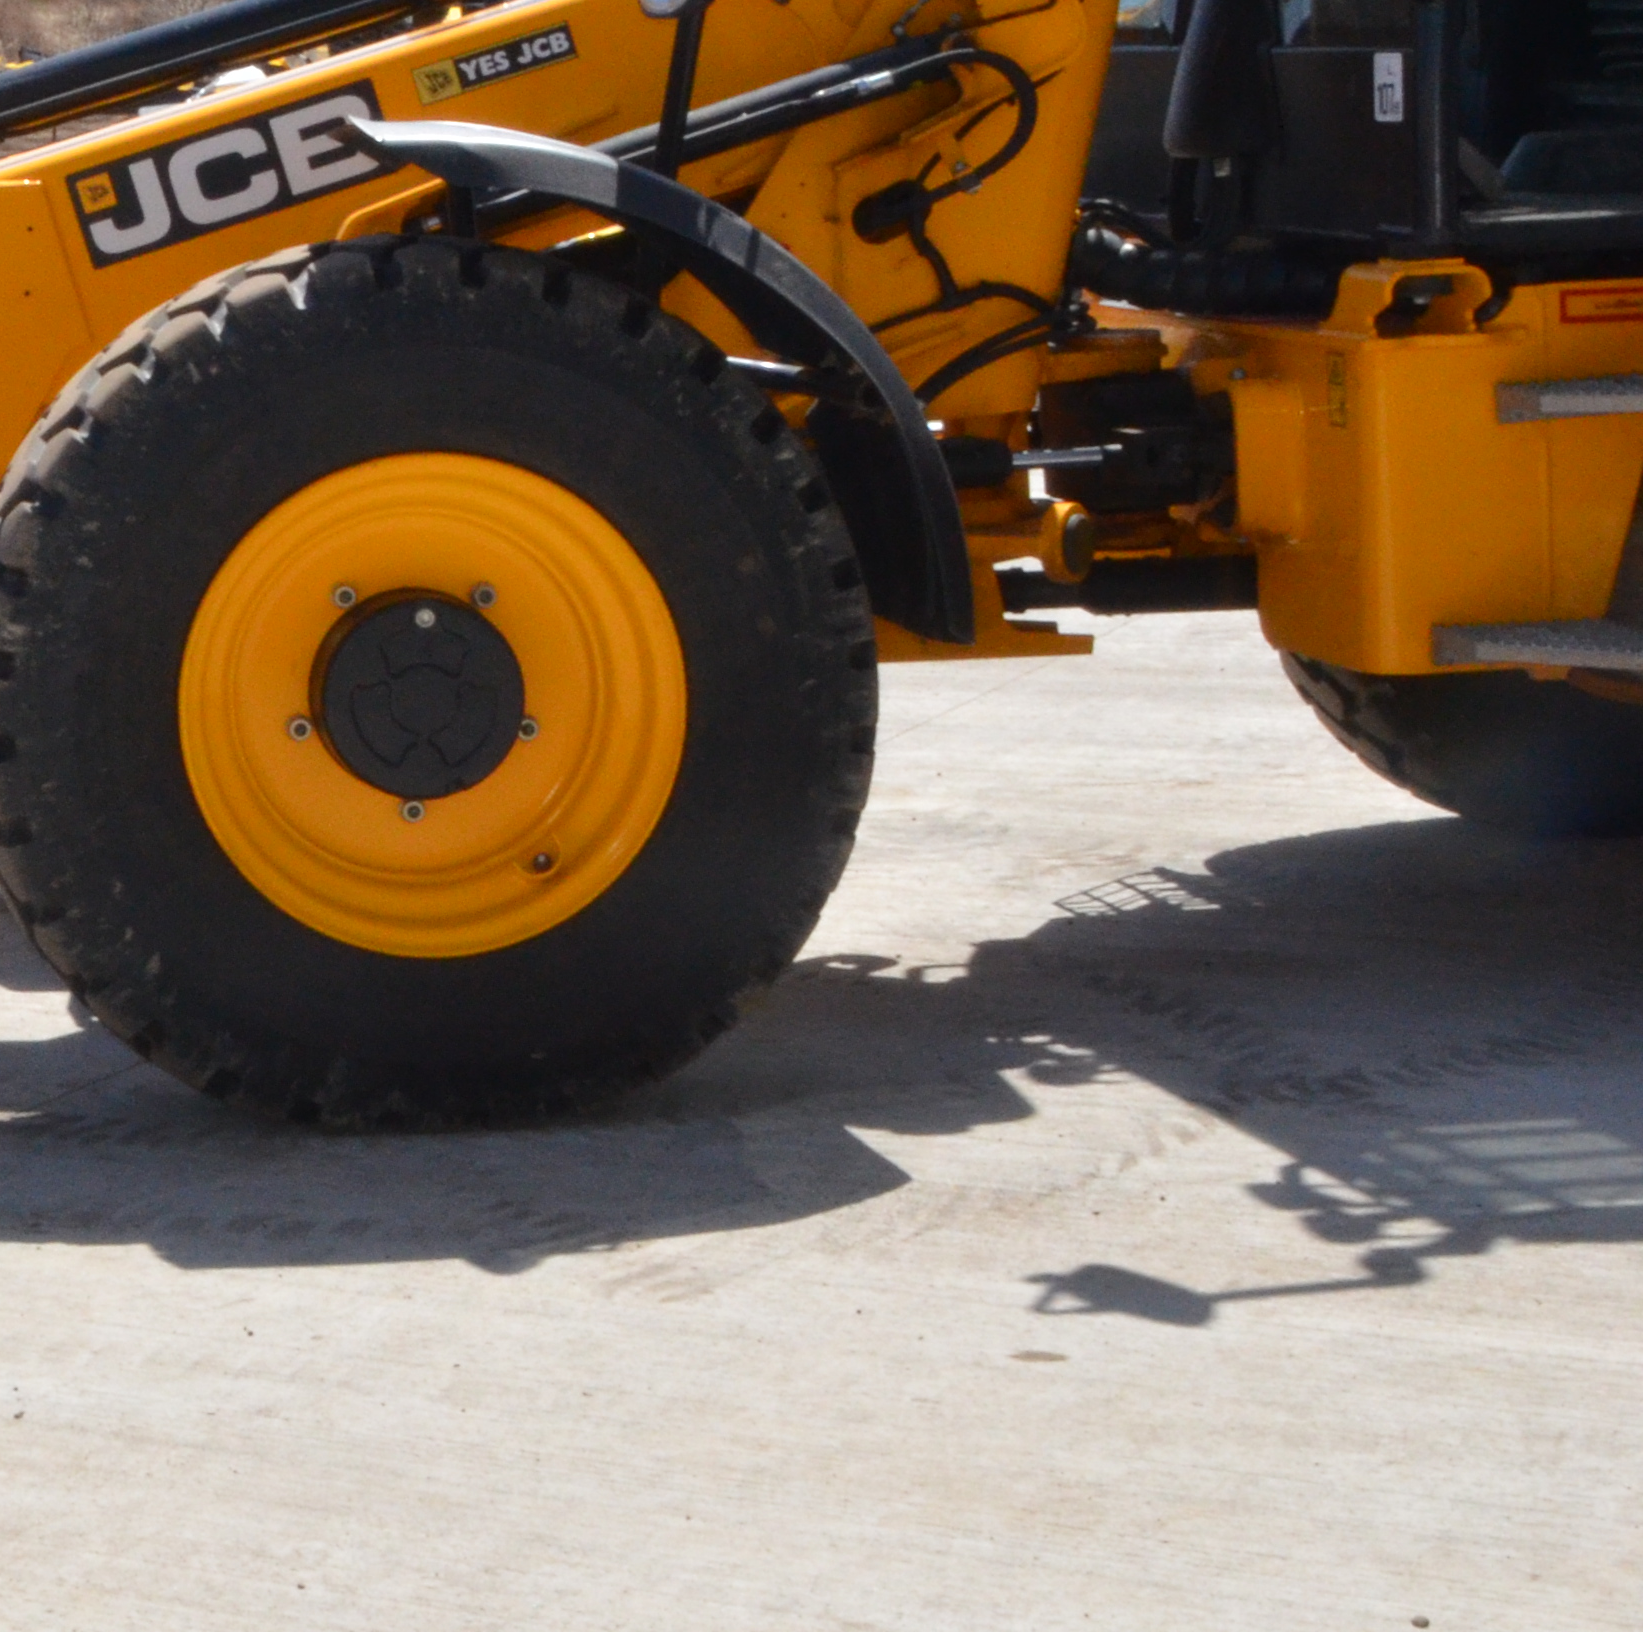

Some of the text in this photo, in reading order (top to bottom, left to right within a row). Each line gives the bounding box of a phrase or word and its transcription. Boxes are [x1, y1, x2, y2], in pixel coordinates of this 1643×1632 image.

[458, 31, 570, 81] YES JCB
[89, 94, 381, 255] JCB
